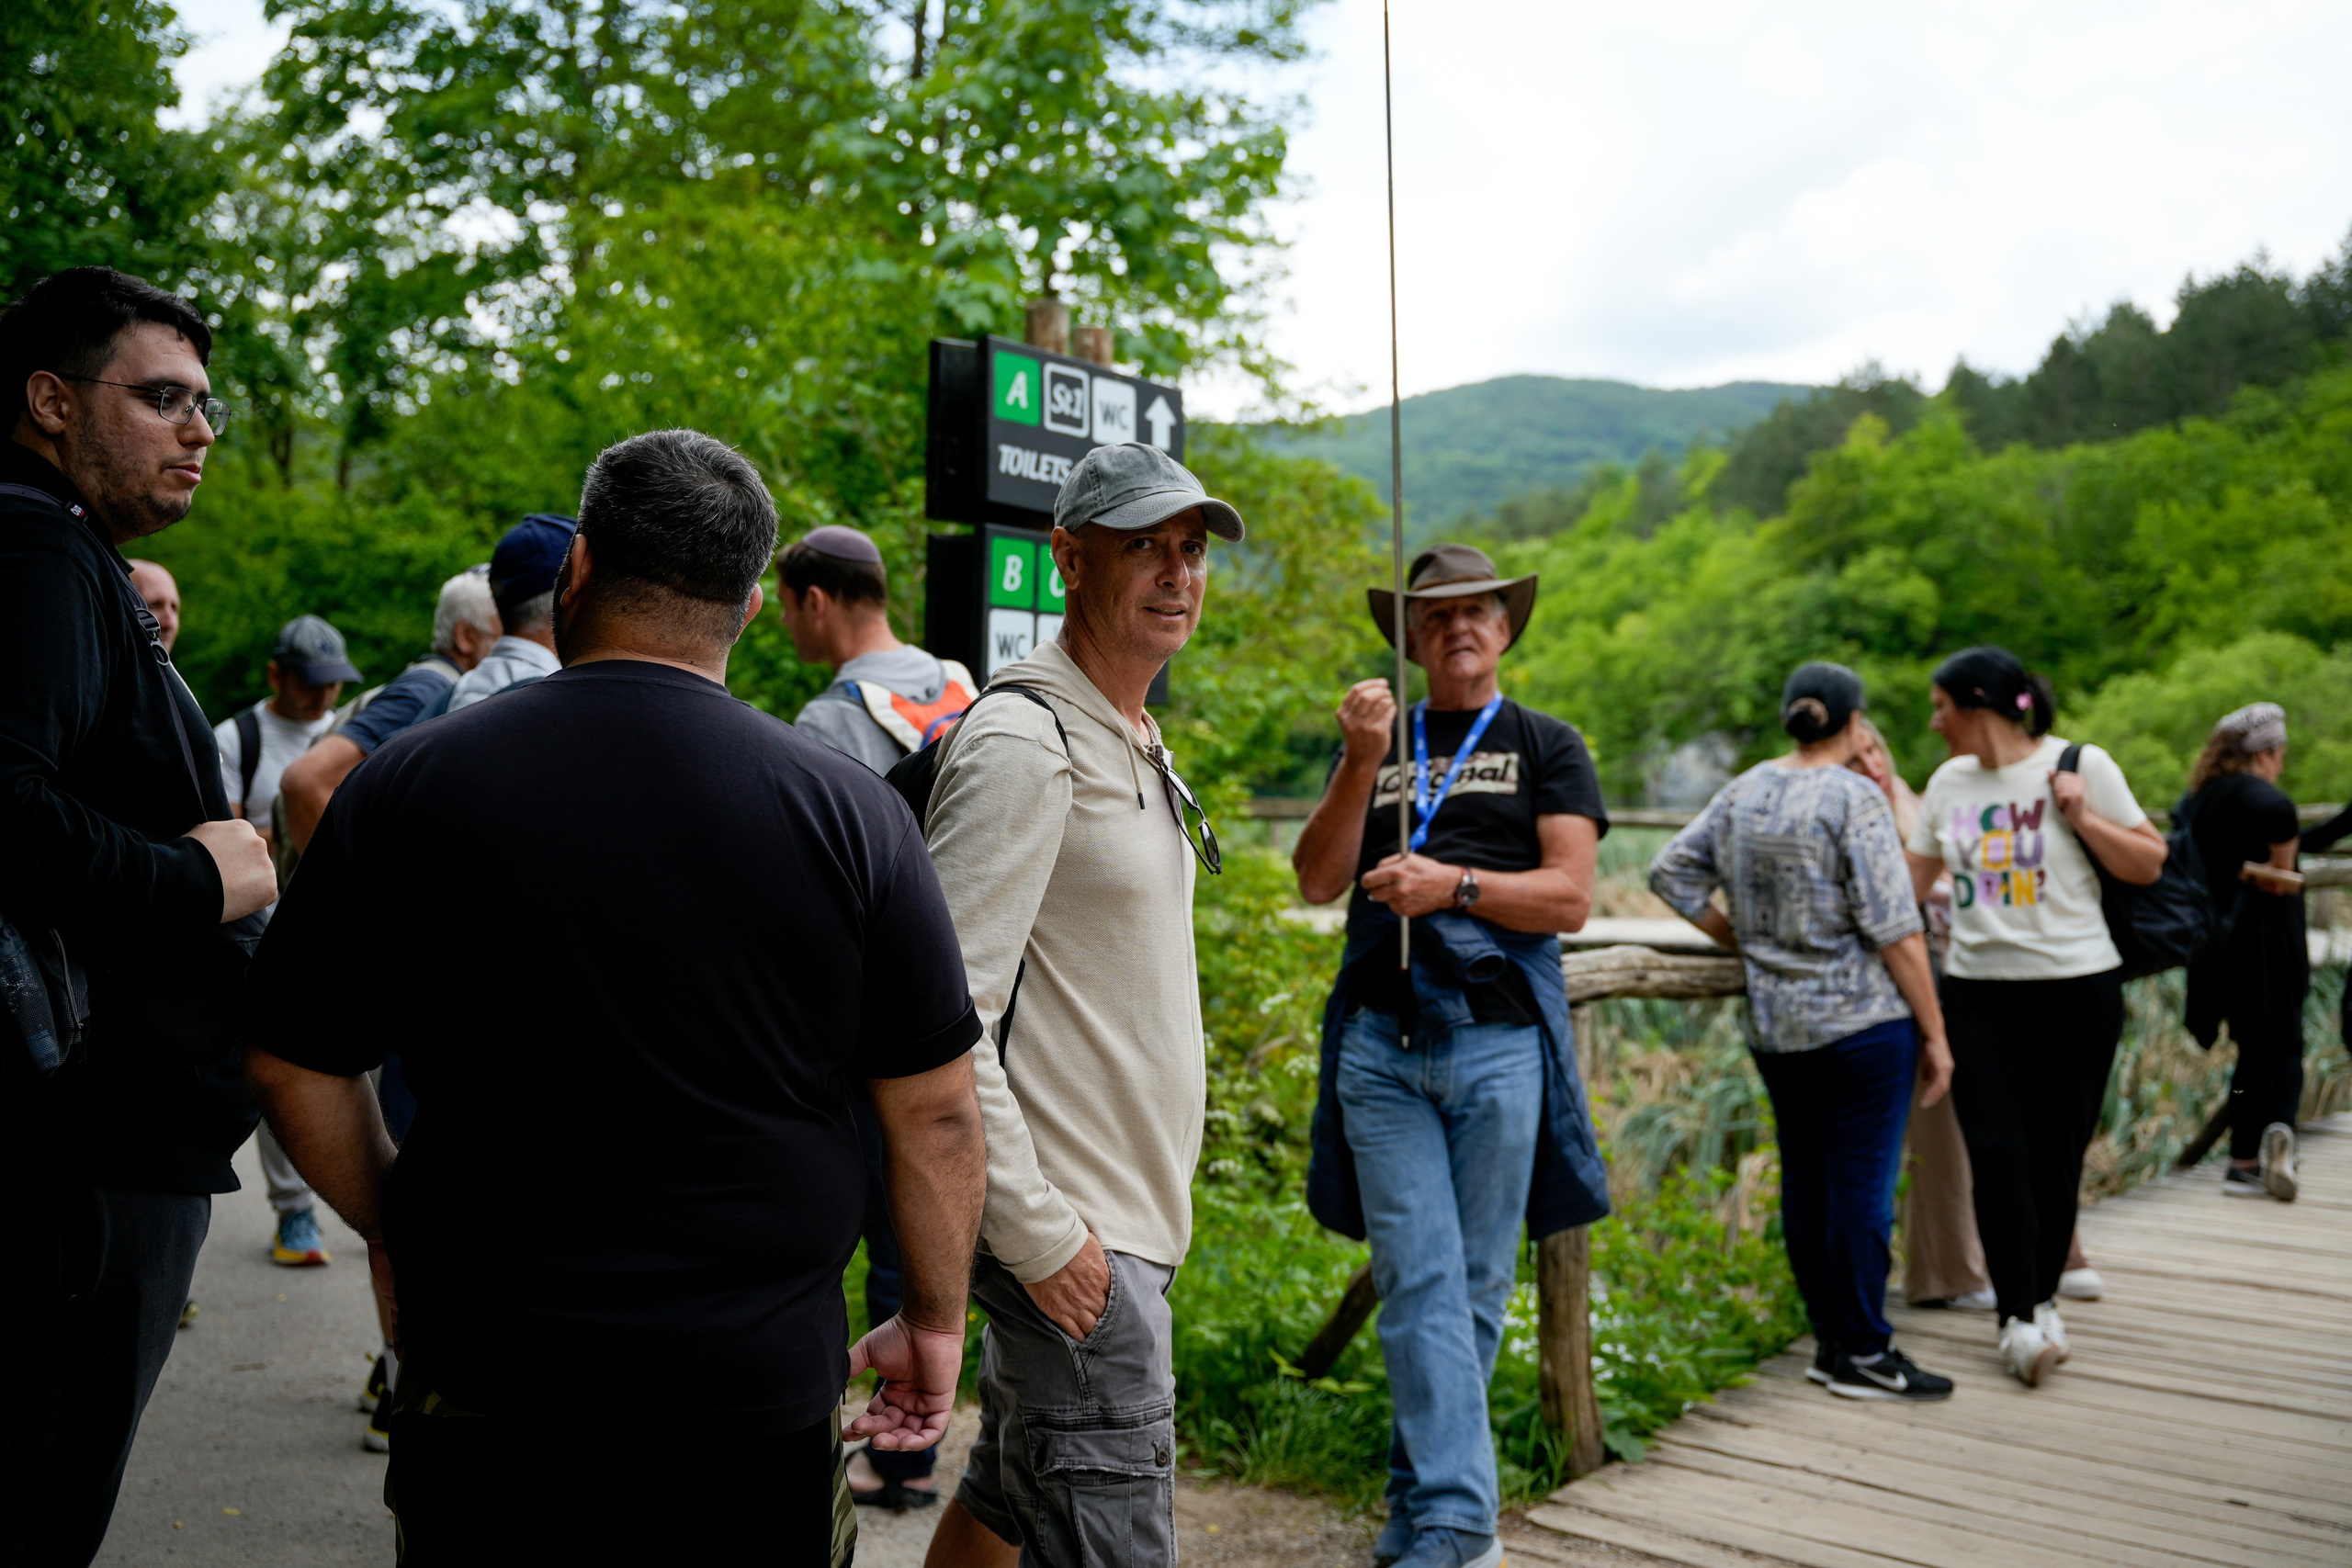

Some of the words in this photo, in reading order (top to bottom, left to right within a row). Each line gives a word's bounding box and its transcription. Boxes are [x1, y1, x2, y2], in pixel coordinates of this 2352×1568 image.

[1006, 371, 1028, 409] A
[1099, 401, 1128, 430] WC
[998, 443, 1073, 487] TOILETS
[1002, 555, 1023, 592] B
[996, 633, 1026, 660] WC
[1382, 759, 1511, 797] Orgnal
[1953, 799, 2045, 840] HOW
[1955, 829, 2044, 870] YOU
